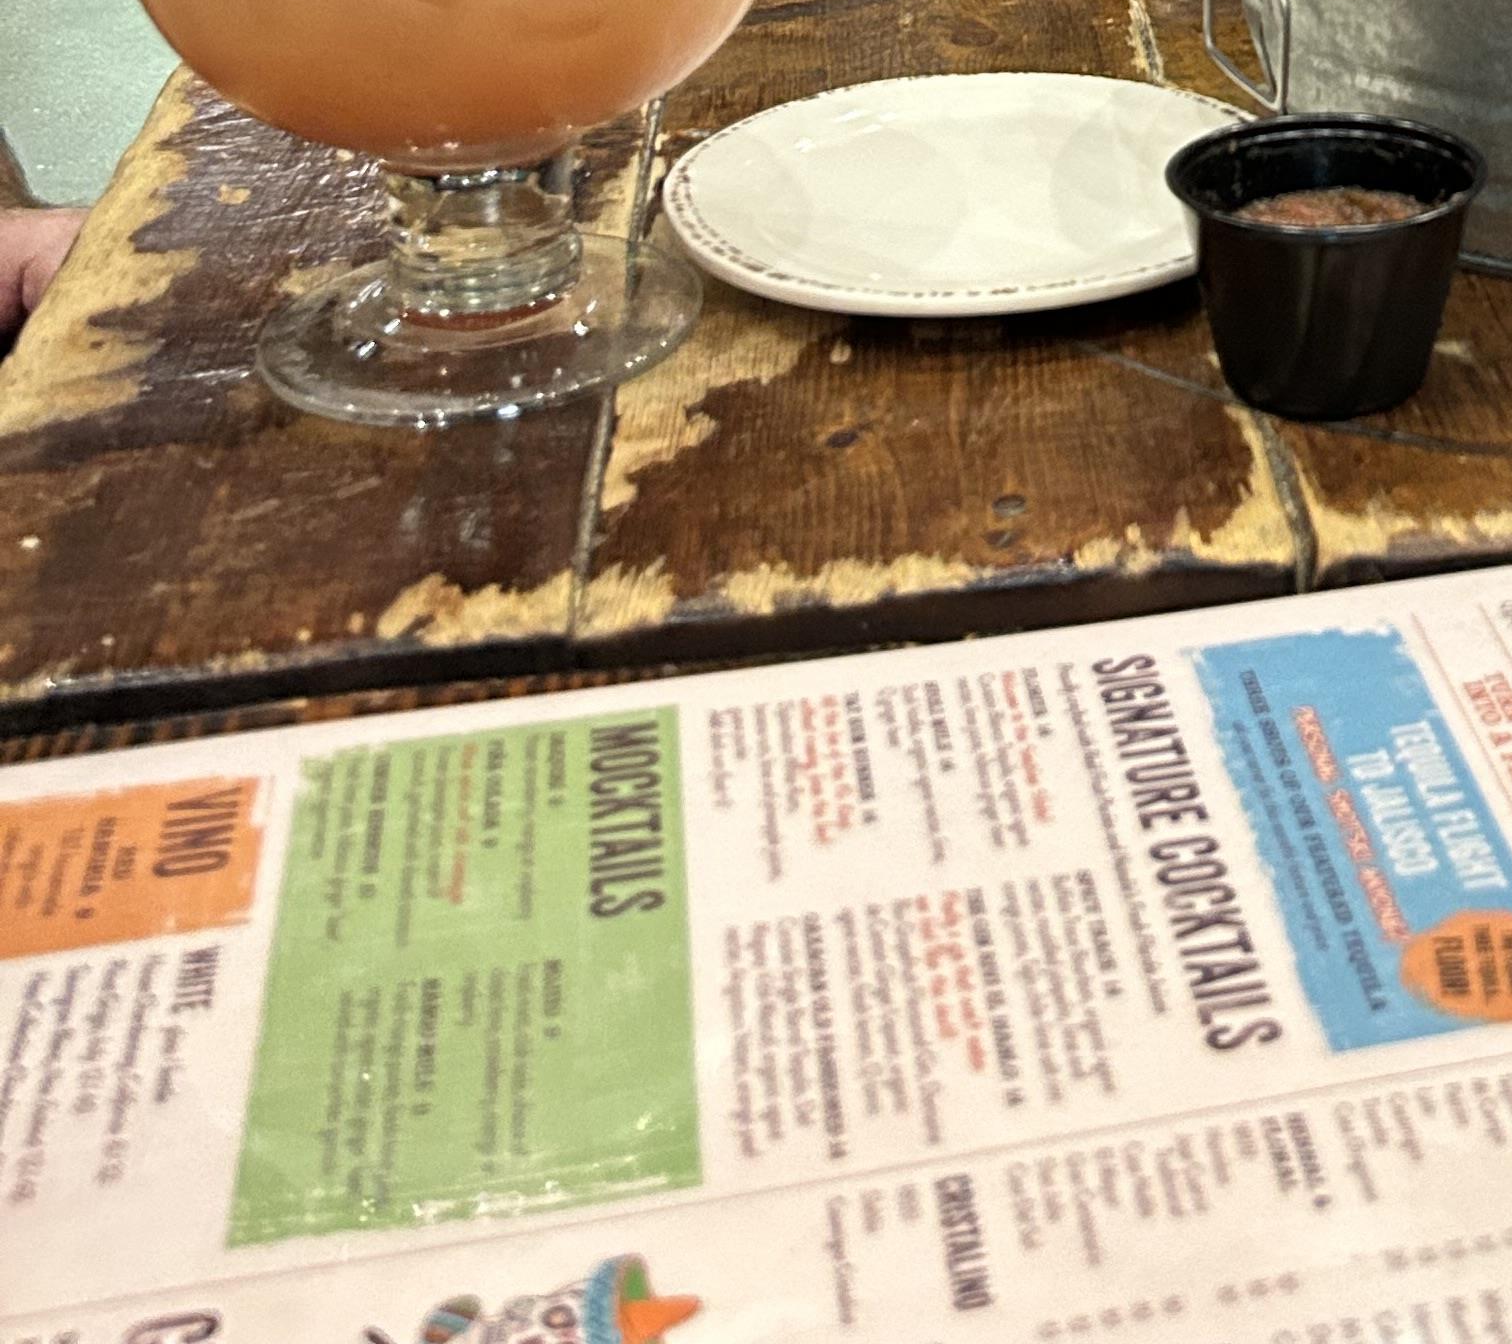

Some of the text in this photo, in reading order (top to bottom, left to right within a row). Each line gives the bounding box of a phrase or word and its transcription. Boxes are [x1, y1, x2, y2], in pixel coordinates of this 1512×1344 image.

[1239, 670, 1270, 715] THREE
[1462, 680, 1503, 725] INTO
[589, 722, 664, 918] MOCKTAILS
[1278, 770, 1301, 793] OF
[1288, 794, 1316, 830] OUR
[1346, 748, 1439, 877] TO JALISCO
[1388, 720, 1507, 890] TEQUILA FLIGHT
[152, 788, 240, 879] VINO
[1093, 655, 1281, 1053] SIGNATURE COCKTAILS
[1303, 833, 1354, 925] FEATURED
[170, 946, 220, 1014] WHITE
[1342, 929, 1388, 1012] TEQUILA
[936, 1175, 992, 1311] CRISTALINO
